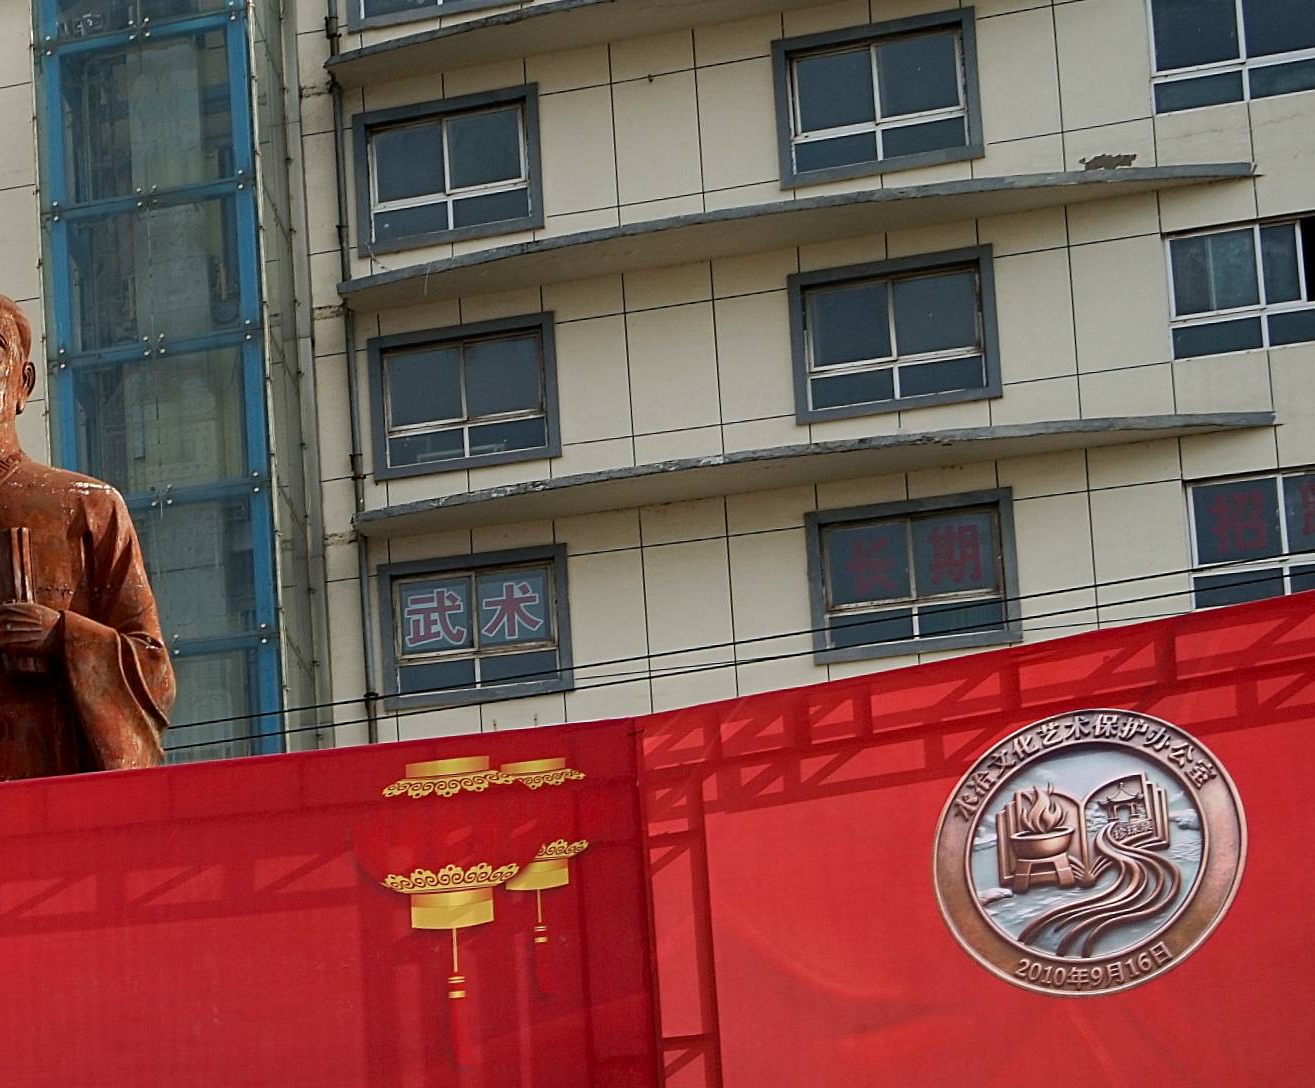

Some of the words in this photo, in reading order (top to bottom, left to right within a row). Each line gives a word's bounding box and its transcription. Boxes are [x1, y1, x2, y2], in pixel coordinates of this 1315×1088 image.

[403, 580, 542, 650] 武术
[1014, 941, 1173, 989] 2010年9月16日
